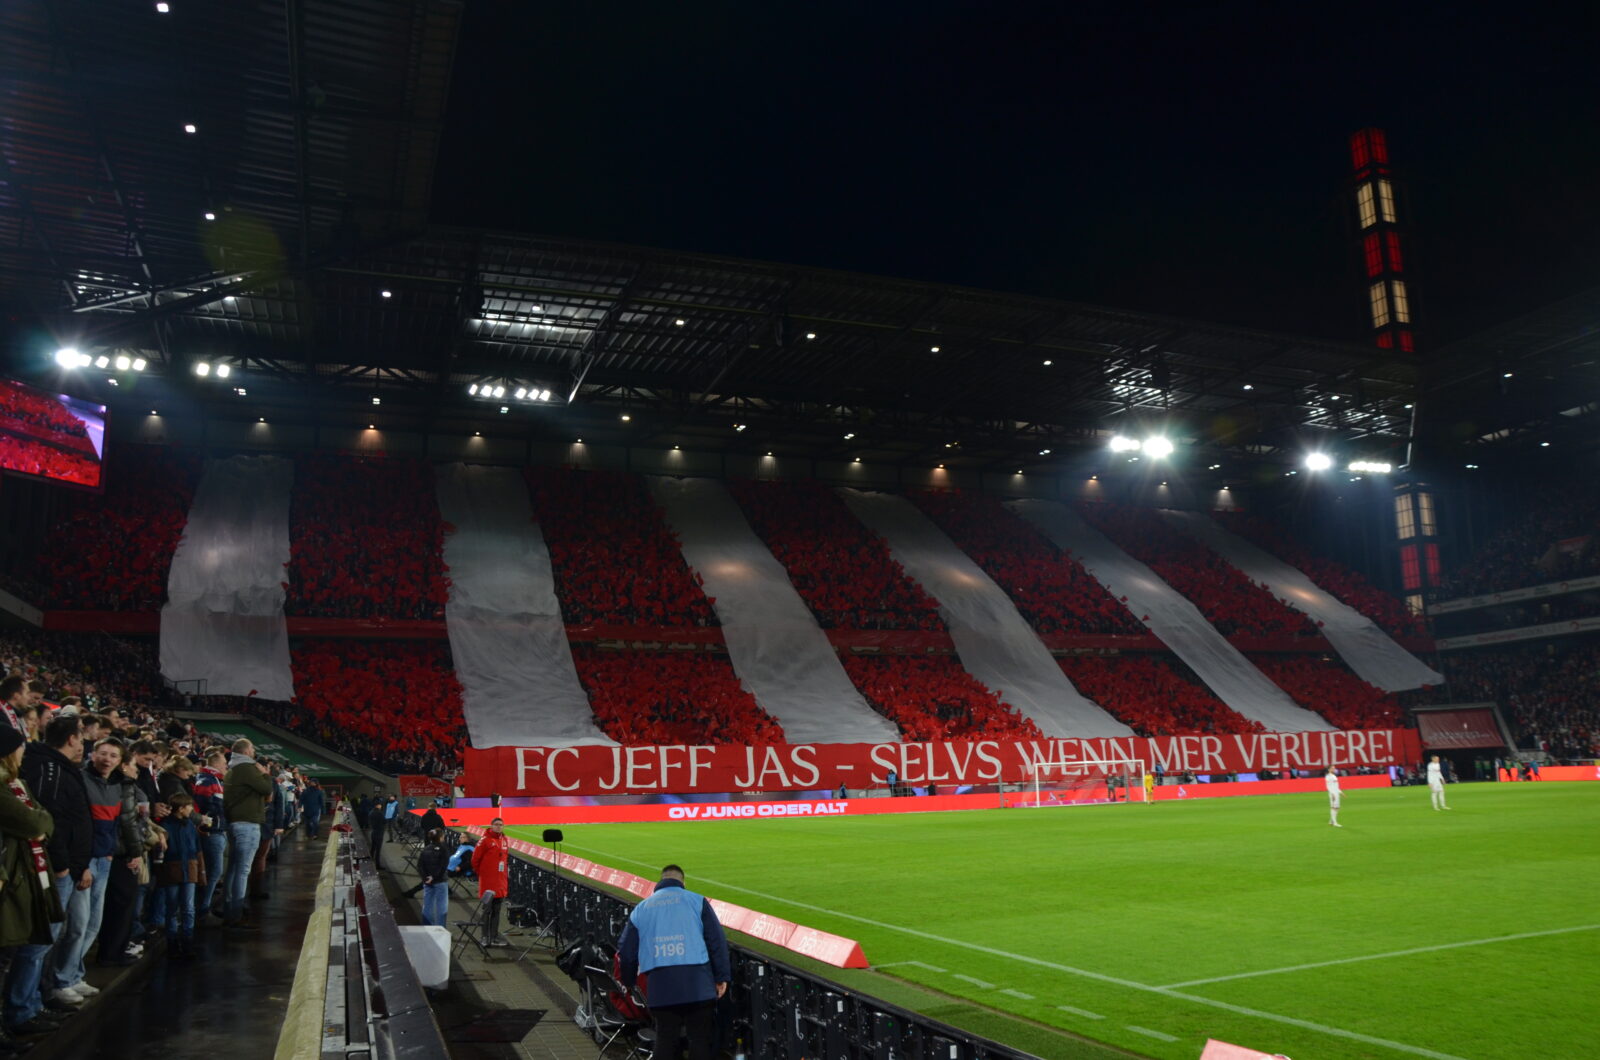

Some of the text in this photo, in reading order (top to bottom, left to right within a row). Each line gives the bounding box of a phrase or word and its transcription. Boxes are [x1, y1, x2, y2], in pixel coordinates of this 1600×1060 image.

[515, 747, 580, 791] FC
[599, 745, 716, 789] JEFF
[734, 745, 820, 788] JAS
[870, 742, 1002, 784] SELVS
[1014, 737, 1136, 776] WENN
[1147, 735, 1226, 773] MER
[1233, 730, 1394, 770] VERLIERE!
[668, 802, 848, 818] OV JUNG ODER ALT
